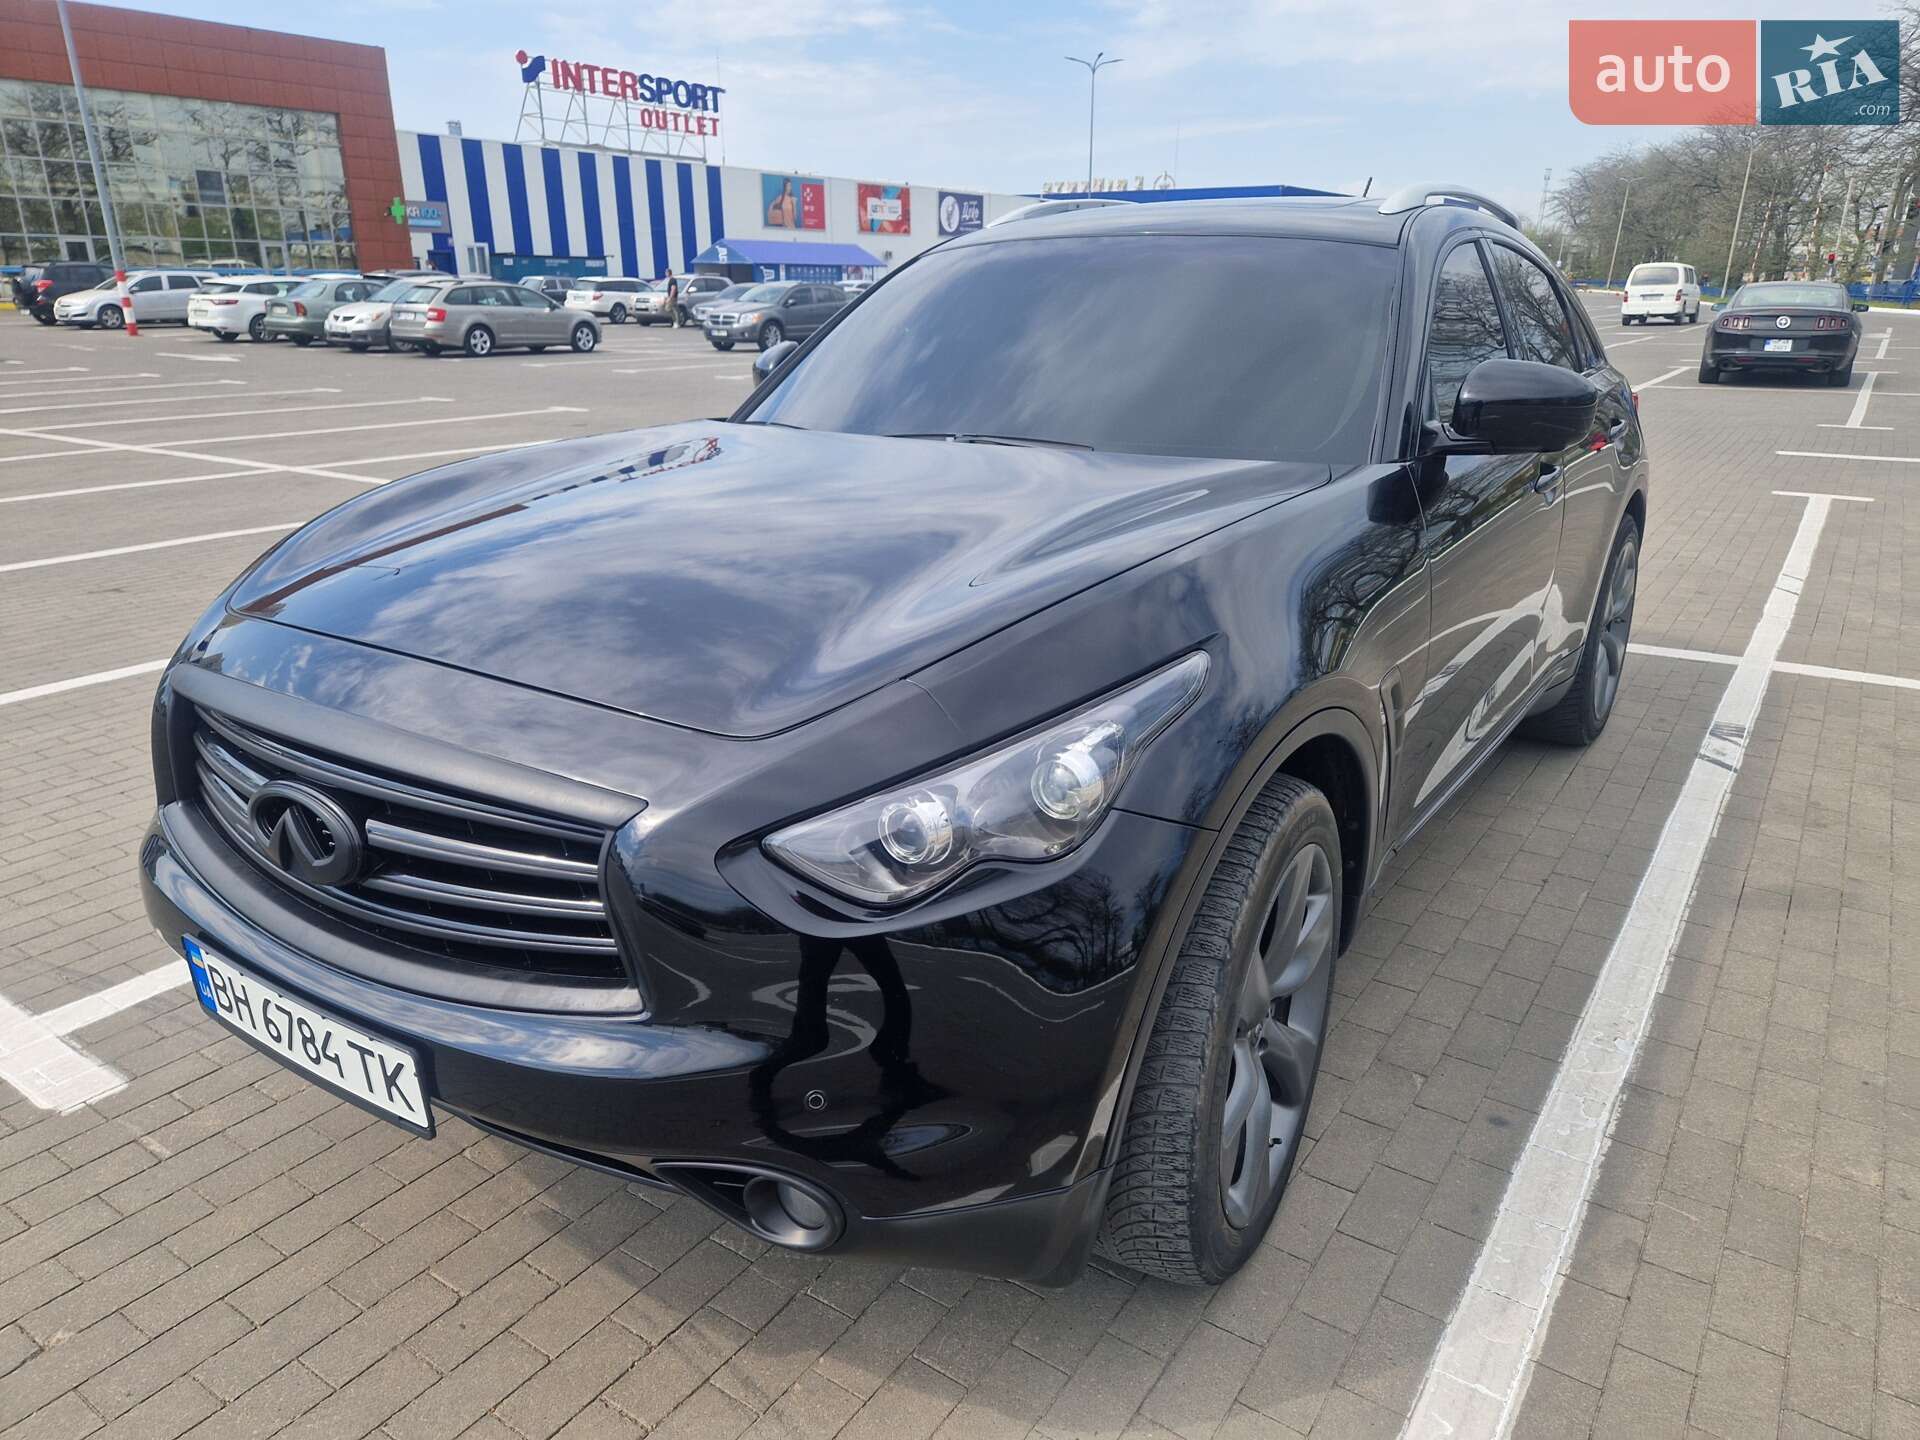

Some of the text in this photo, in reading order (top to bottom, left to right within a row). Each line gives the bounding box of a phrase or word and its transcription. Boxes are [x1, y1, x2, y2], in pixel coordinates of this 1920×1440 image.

[551, 58, 723, 113] INTERSPORT
[640, 108, 719, 137] OUTLET
[207, 964, 415, 1113] BH 6784 TK
